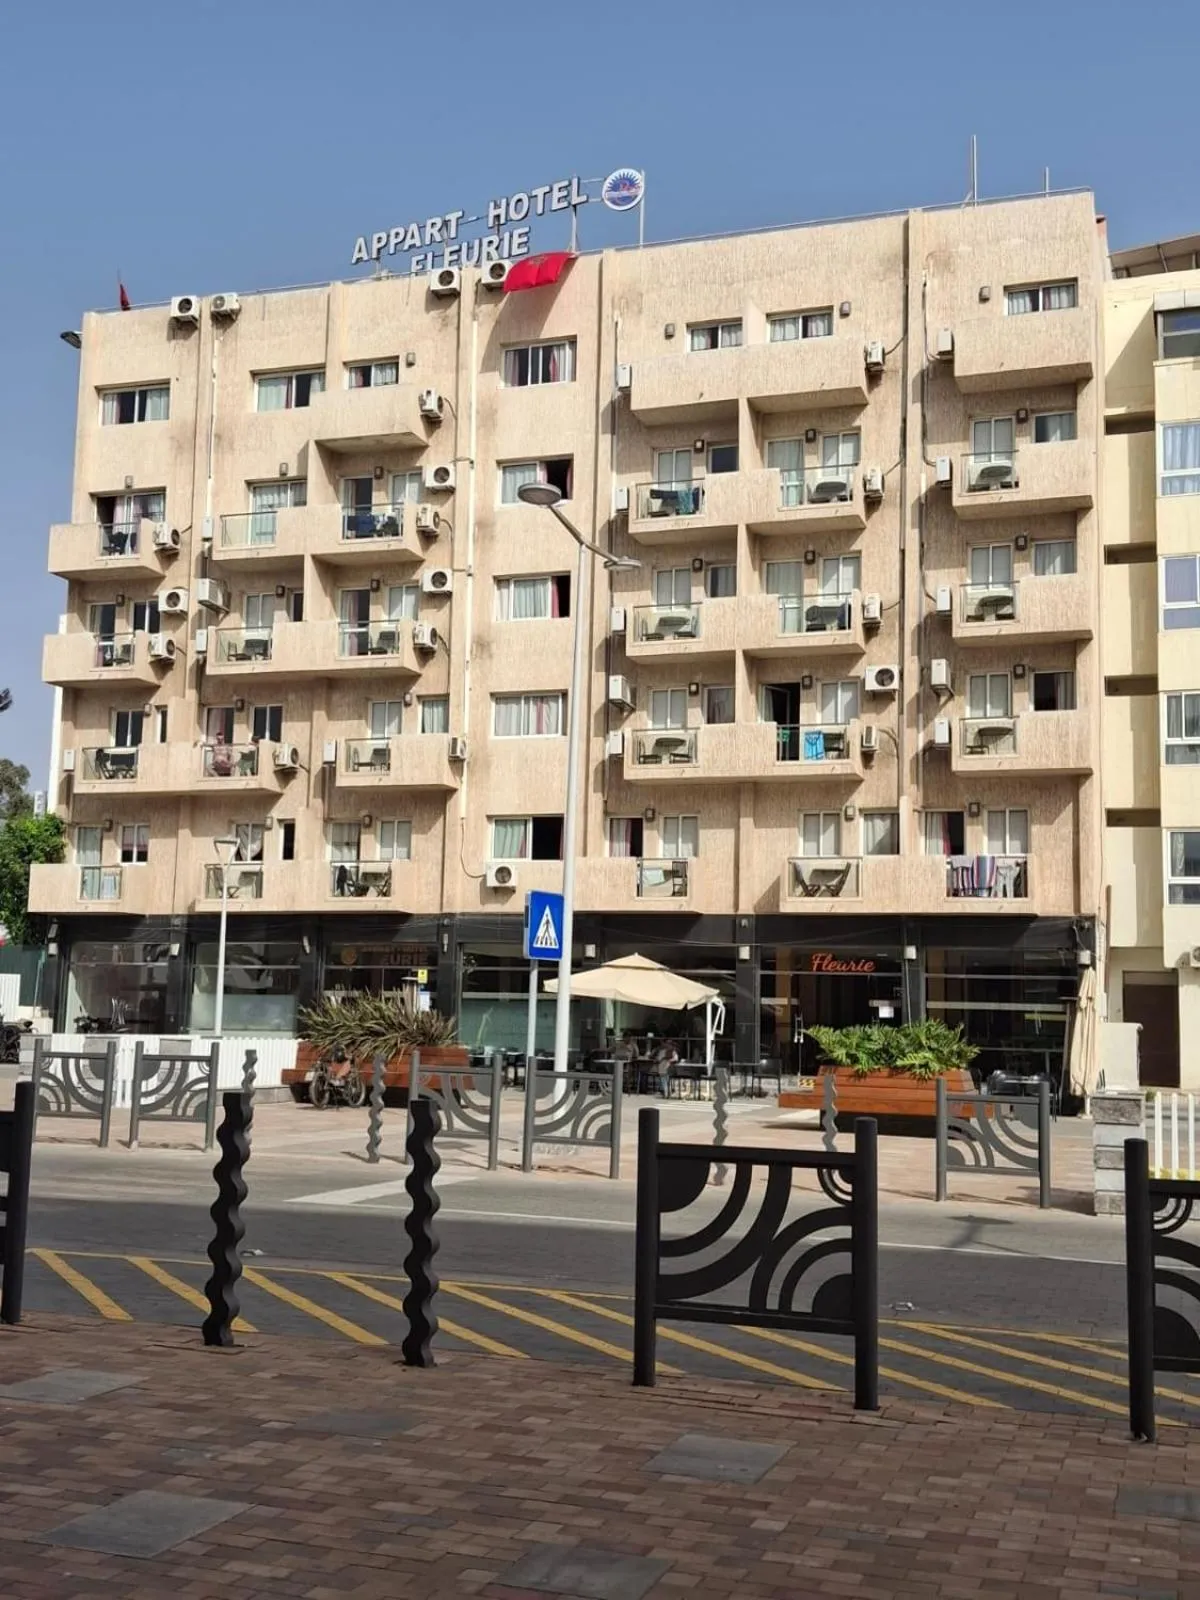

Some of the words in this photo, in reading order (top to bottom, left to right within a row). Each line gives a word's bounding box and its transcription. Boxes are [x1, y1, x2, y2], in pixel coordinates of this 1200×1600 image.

[351, 209, 465, 265] APPART
[487, 176, 589, 229] HOTEL
[812, 952, 876, 972] Fleurie
